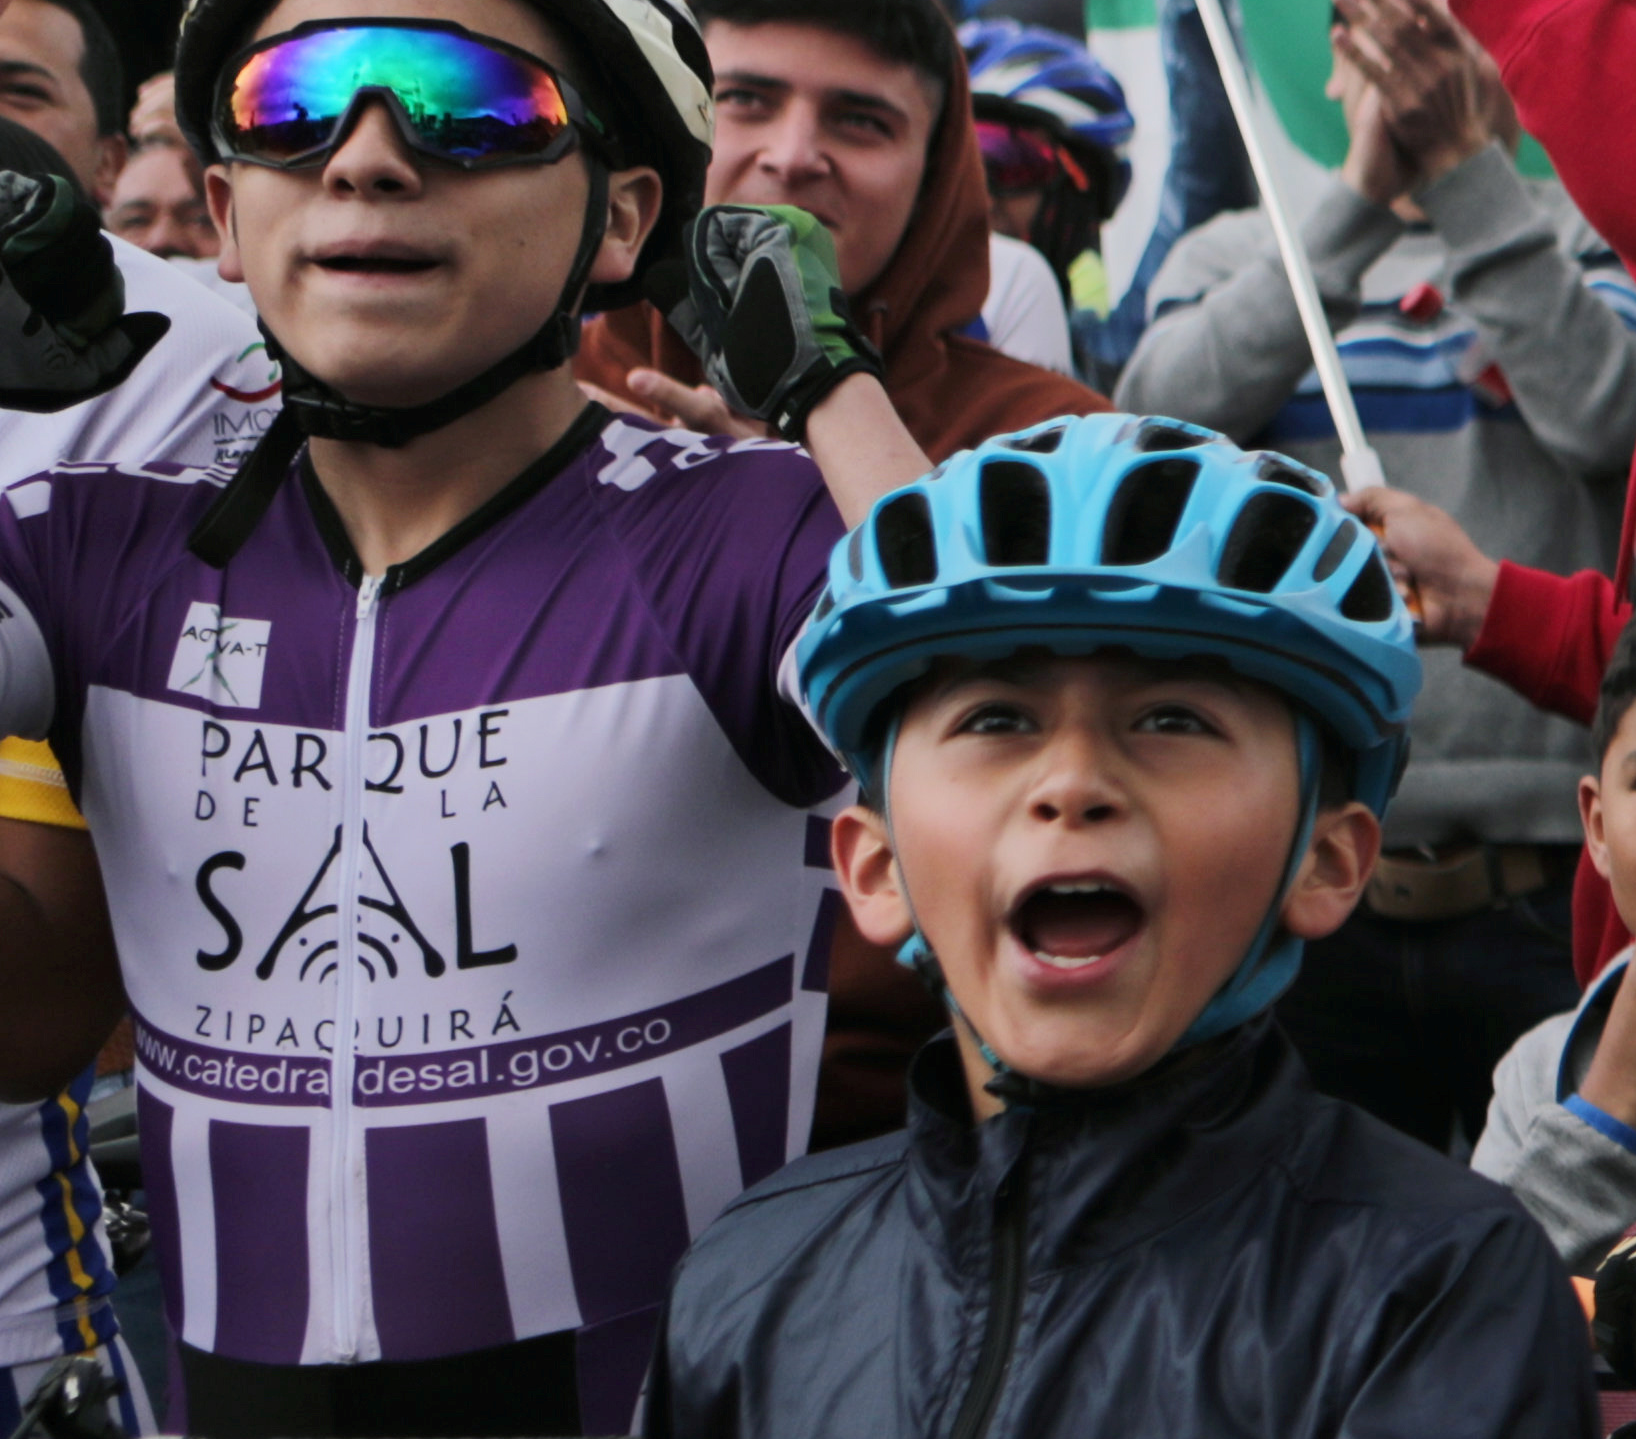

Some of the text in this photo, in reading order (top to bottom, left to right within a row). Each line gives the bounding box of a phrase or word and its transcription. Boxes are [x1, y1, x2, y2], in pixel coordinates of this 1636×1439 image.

[213, 408, 280, 436] IMC
[202, 709, 511, 795] PARQUE
[195, 778, 508, 829] DE LA
[195, 820, 519, 982] SAL
[134, 1013, 673, 1096] www.catedradesal.gov.co
